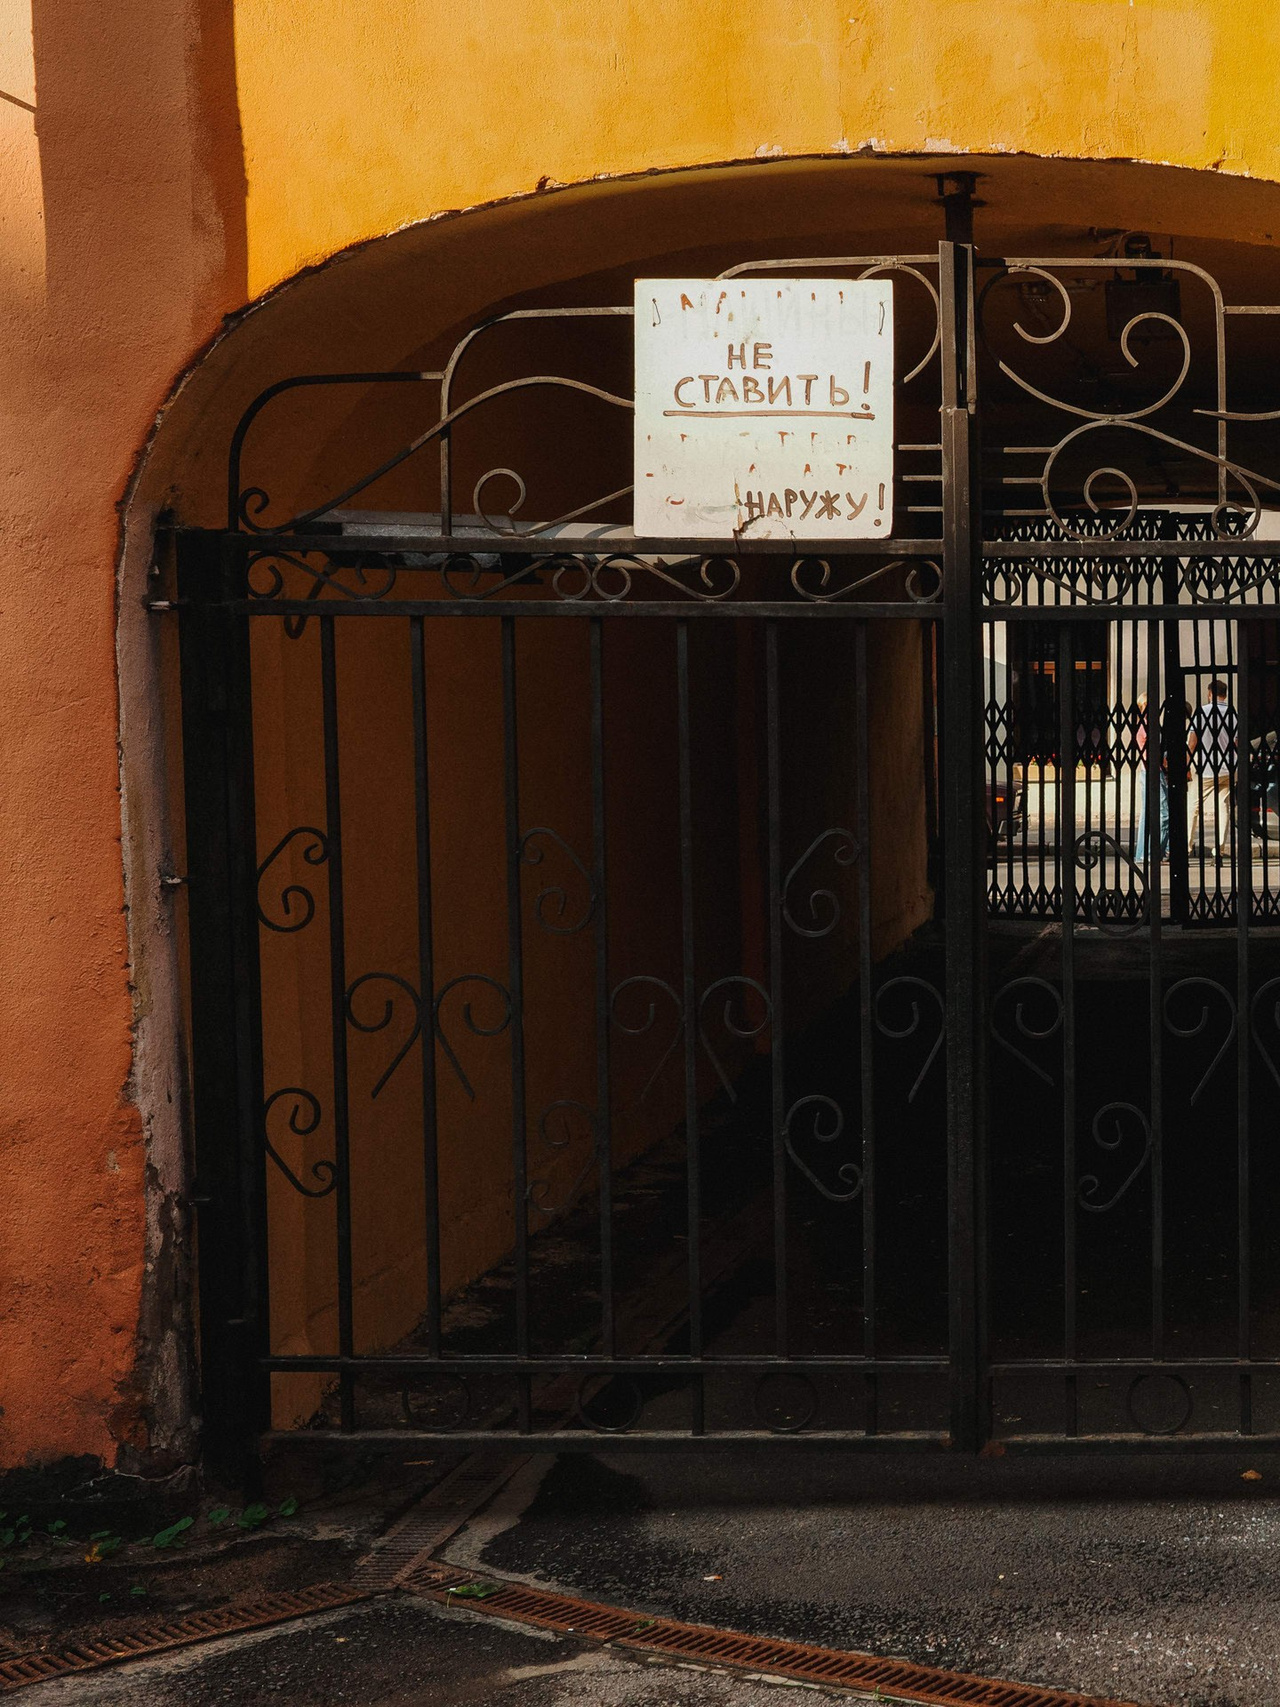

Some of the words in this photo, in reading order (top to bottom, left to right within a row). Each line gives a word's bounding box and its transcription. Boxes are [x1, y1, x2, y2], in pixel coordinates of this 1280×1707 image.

[727, 341, 774, 371] НЕ
[673, 360, 877, 411] СТАВИТЬ!
[743, 482, 886, 528] НАРУЖУ!
